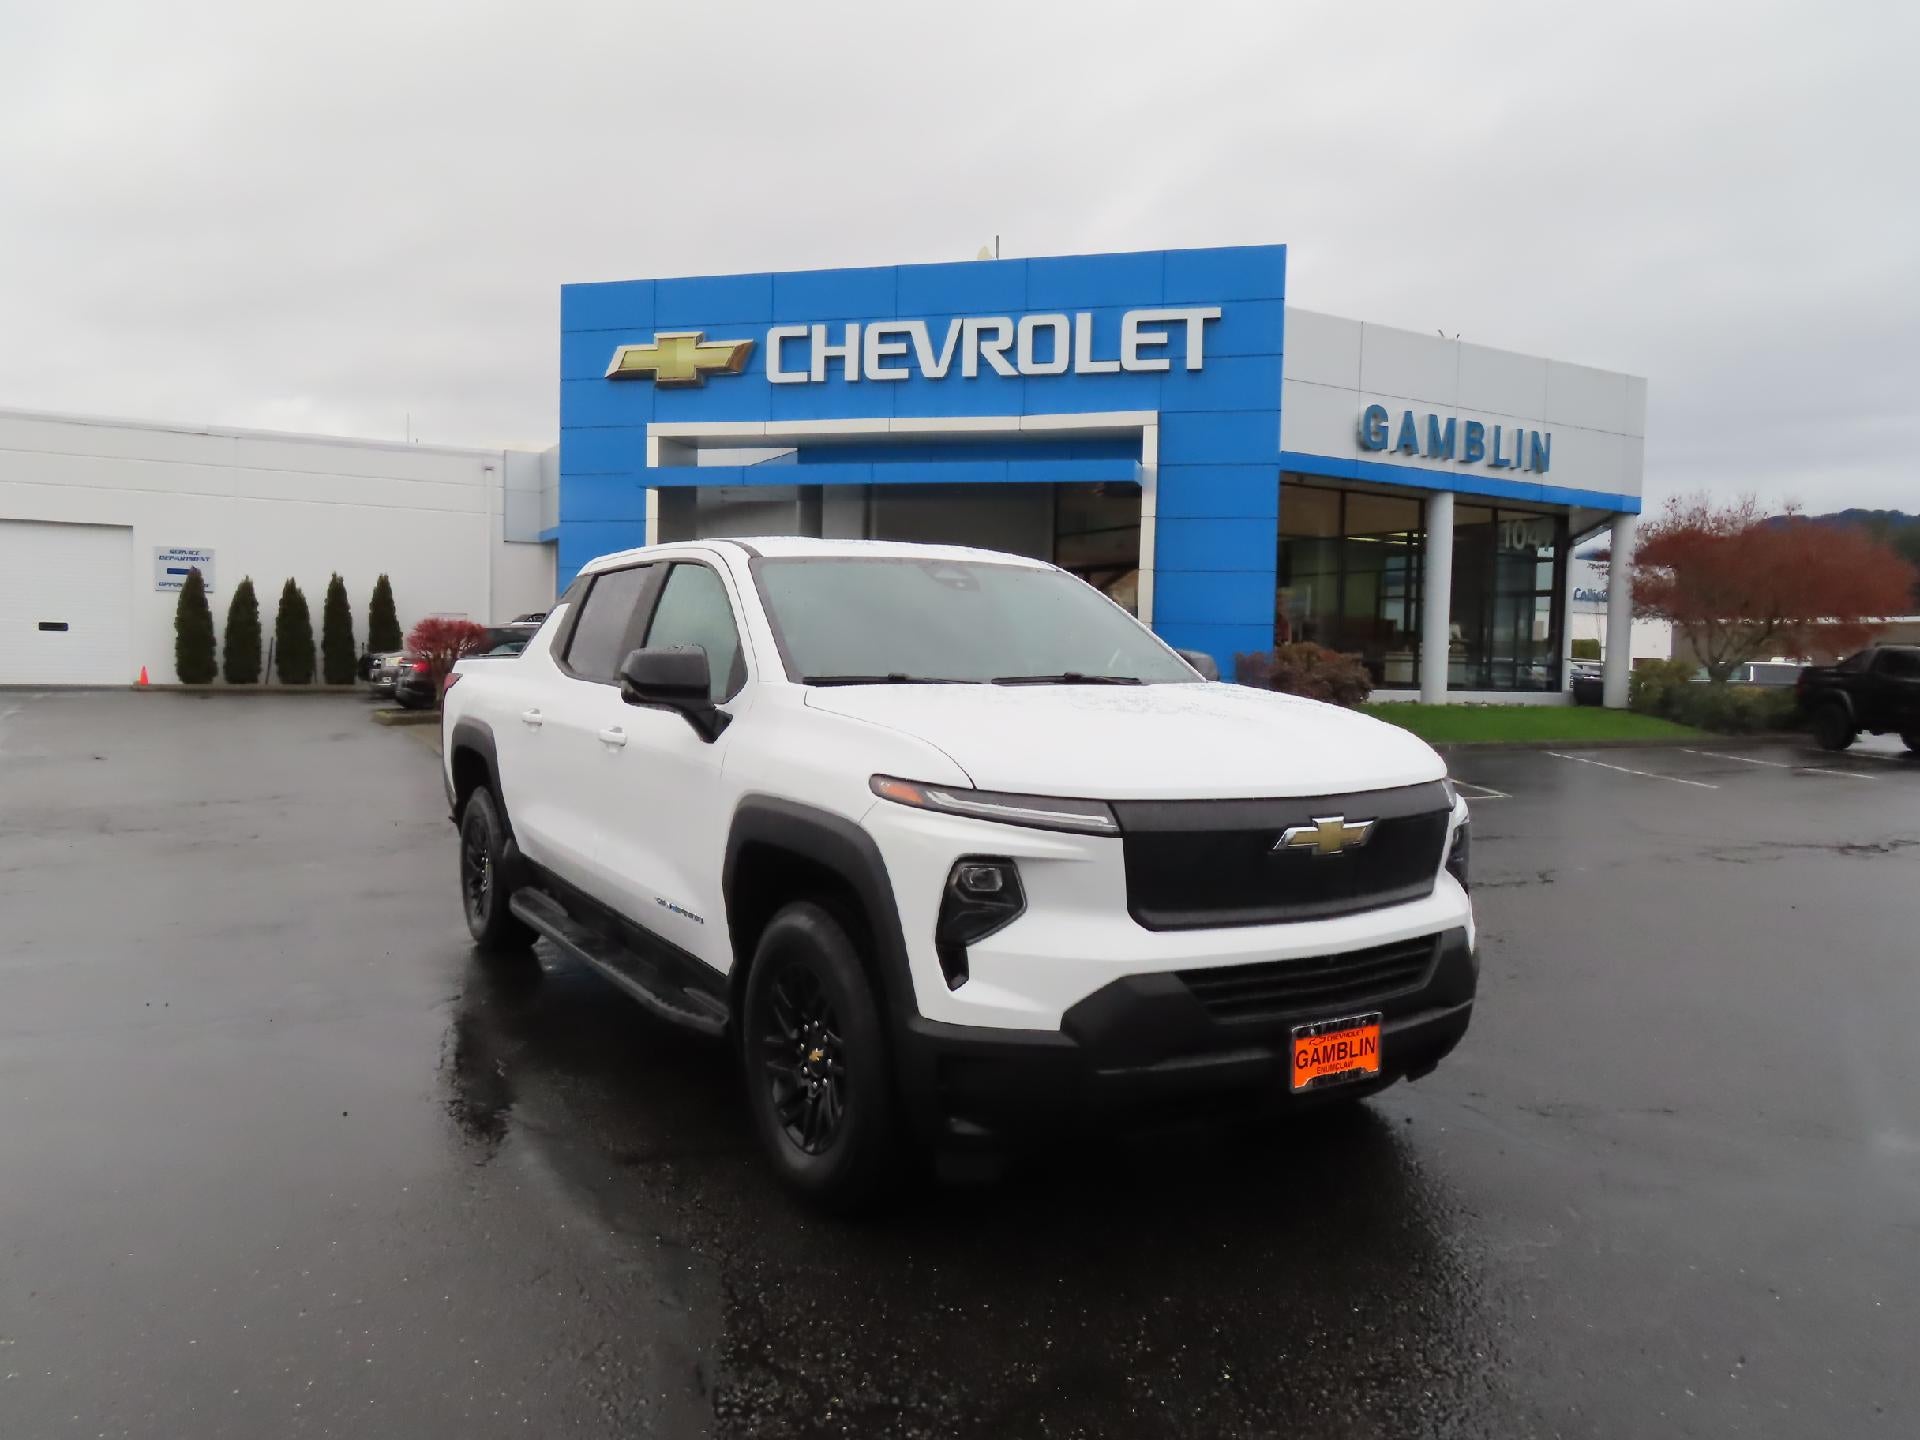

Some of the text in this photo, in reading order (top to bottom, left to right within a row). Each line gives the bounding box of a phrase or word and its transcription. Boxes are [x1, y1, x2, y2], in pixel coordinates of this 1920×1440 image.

[766, 306, 1222, 384] CHEVROLET
[1360, 404, 1551, 474] GAMBLIN
[1326, 1029, 1364, 1042] CHEVROLET
[1295, 1036, 1376, 1070] GAMBLIN
[1316, 1060, 1354, 1075] ENUMCLAW
